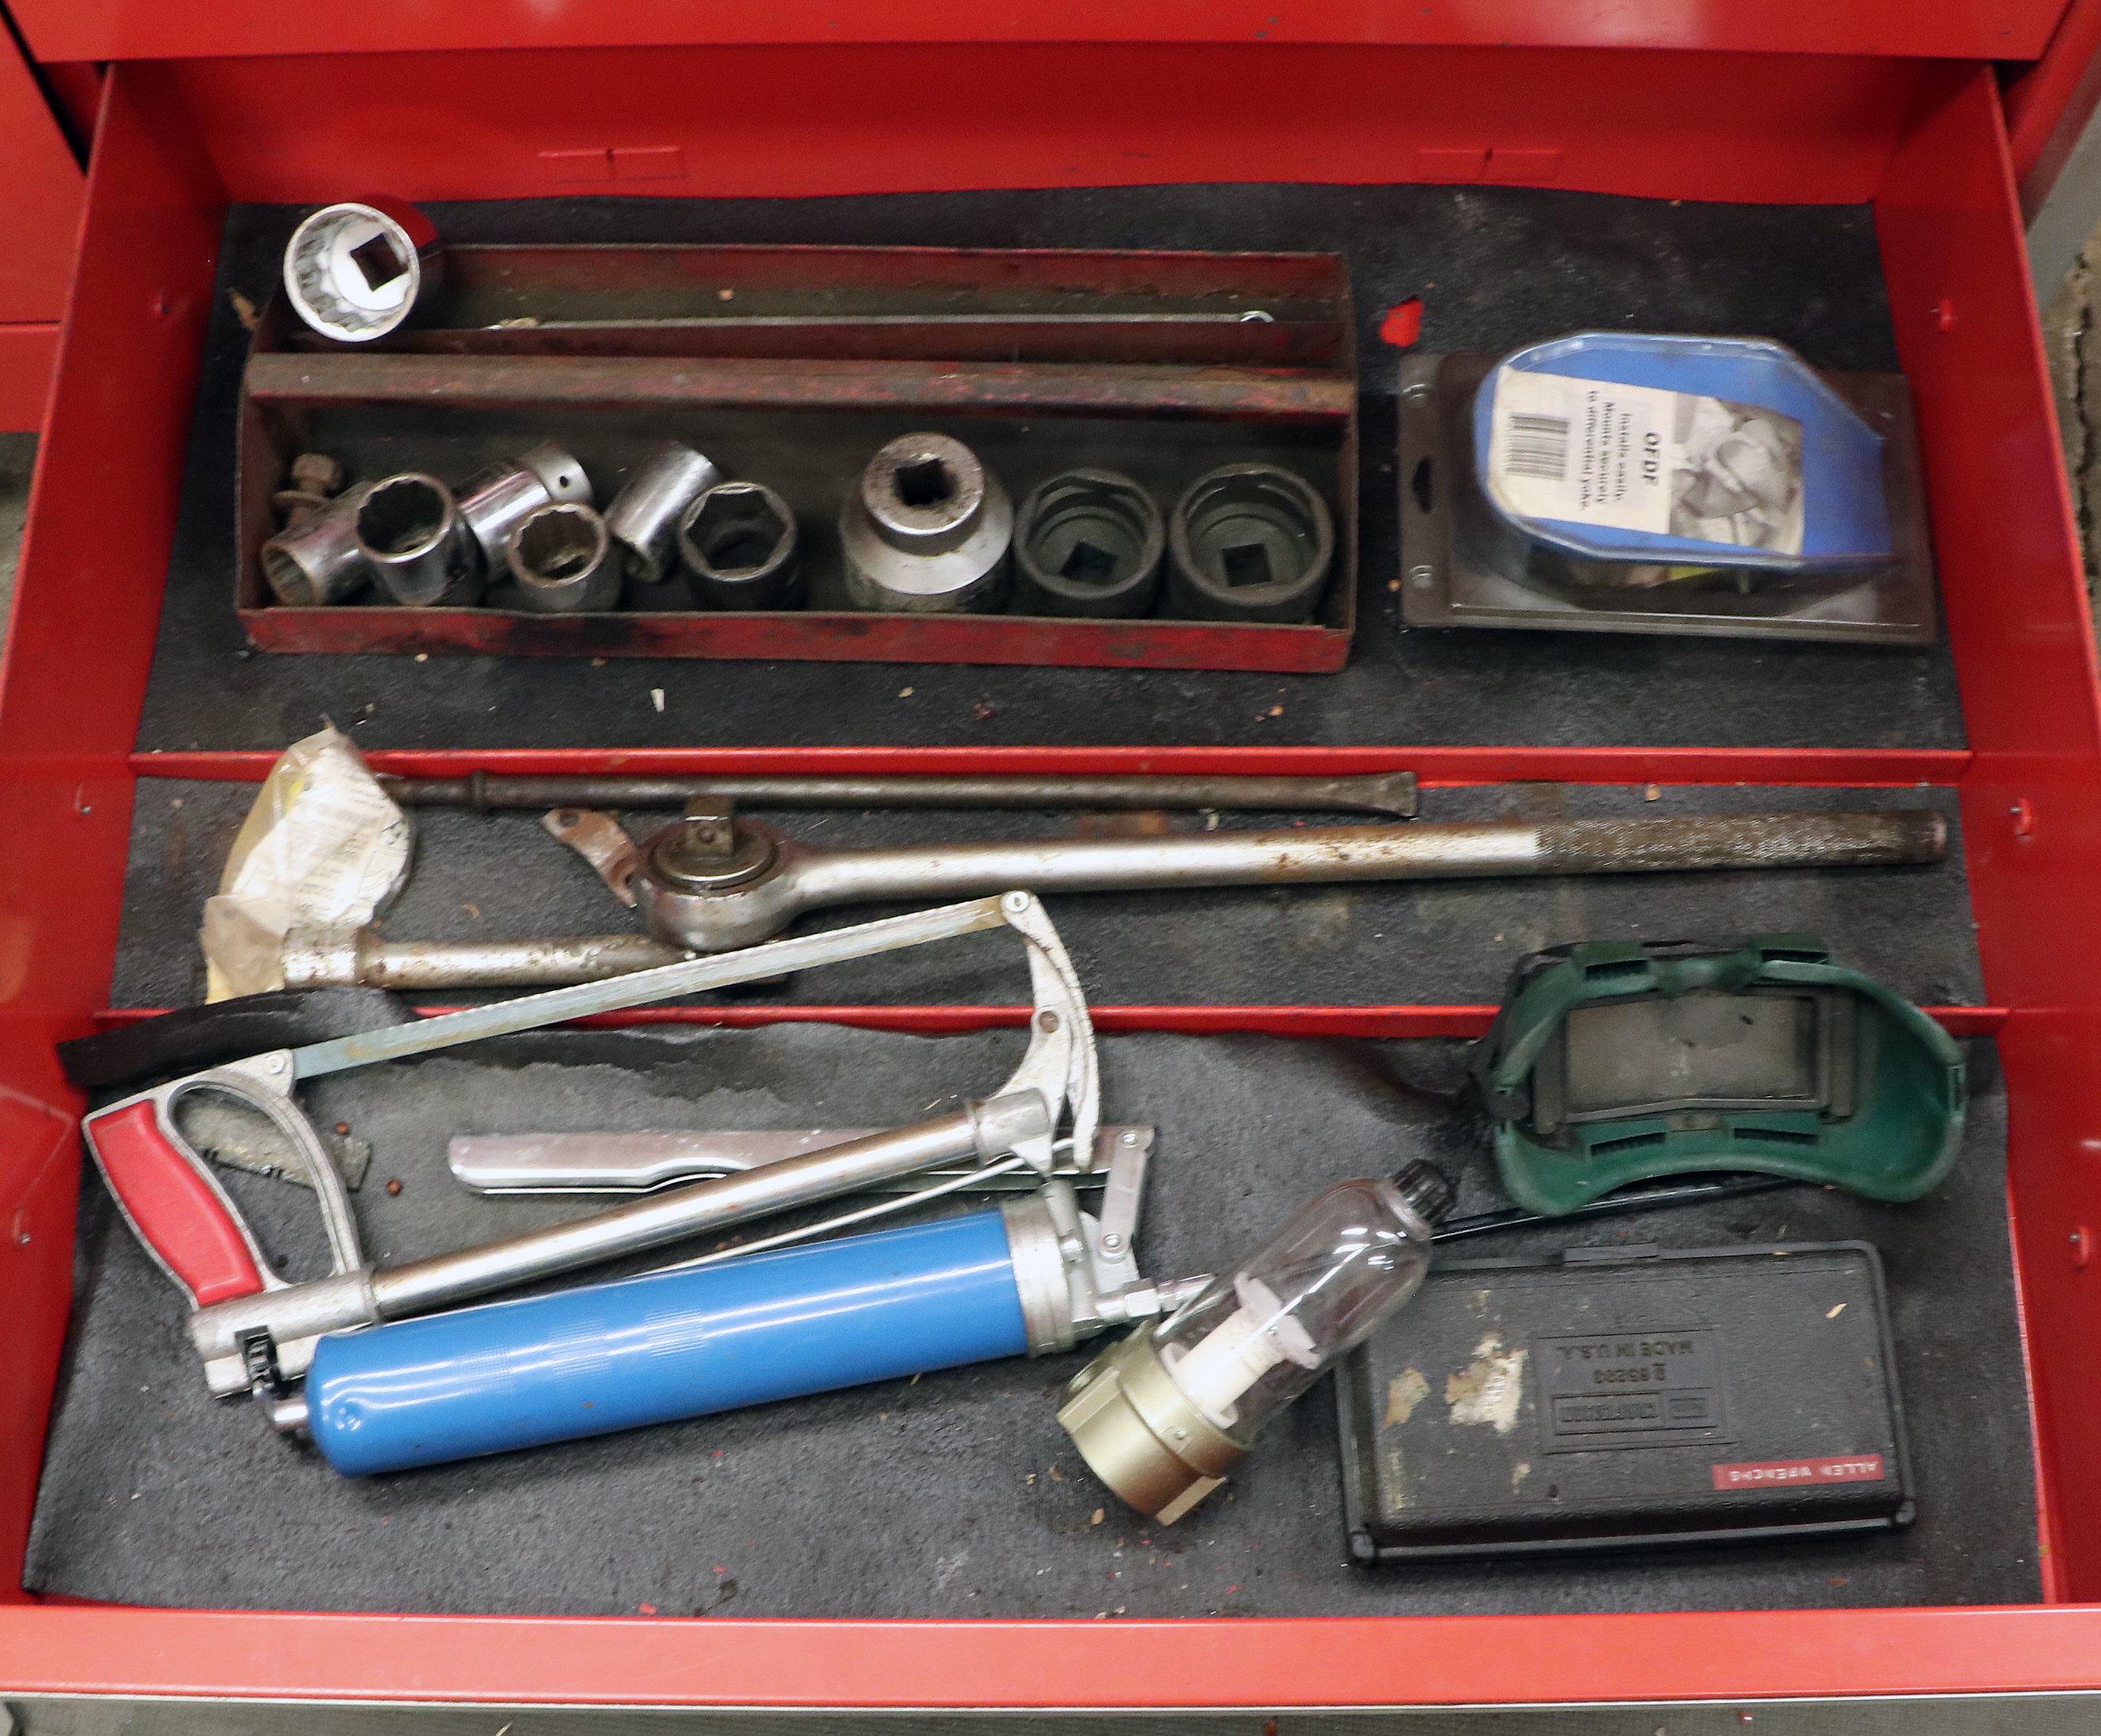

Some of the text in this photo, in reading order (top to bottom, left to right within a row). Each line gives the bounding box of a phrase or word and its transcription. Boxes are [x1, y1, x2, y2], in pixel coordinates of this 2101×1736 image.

[1601, 402, 1616, 446] Mounts
[1617, 413, 1633, 457] Installs
[1642, 431, 1660, 486] OFDF
[1616, 1342, 1637, 1358] IN
[1641, 1340, 1694, 1356] MADE
[1820, 1461, 1878, 1477] ALLEN
